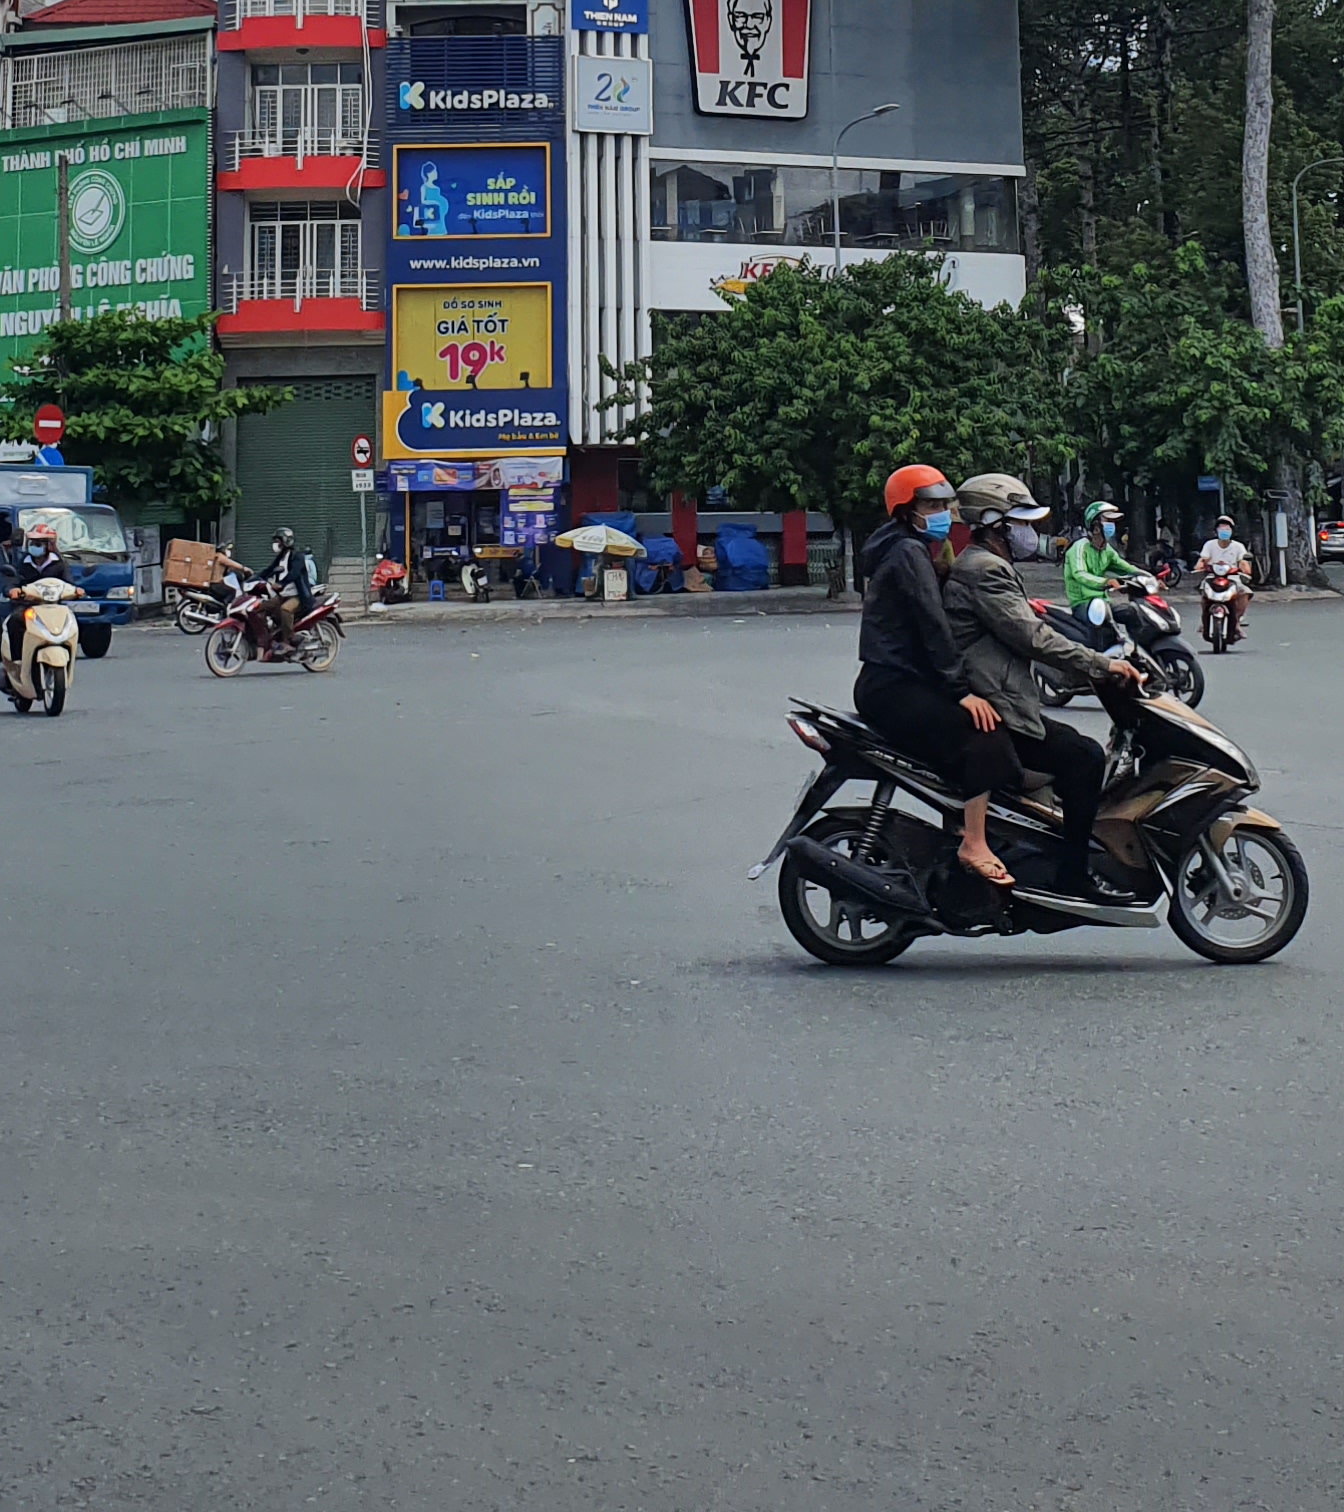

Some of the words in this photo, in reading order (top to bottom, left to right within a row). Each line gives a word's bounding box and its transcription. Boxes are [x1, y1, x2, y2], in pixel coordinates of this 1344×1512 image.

[614, 14, 637, 23] NAM
[716, 80, 790, 109] KFC
[1, 150, 51, 172] THÀNH
[55, 140, 85, 166] PHỐ
[89, 138, 111, 162] HỒ
[114, 137, 141, 159] CHÍ
[144, 136, 187, 156] MINH
[487, 172, 516, 189] SẮP
[467, 192, 505, 205] SINH
[507, 184, 536, 205] RỒI
[28, 261, 83, 291] PHÒG
[86, 256, 131, 287] CÔNG
[135, 250, 194, 283] CHỨNG
[409, 256, 540, 271] www.kidsplaza.vn
[443, 298, 458, 309] ĐỒ
[478, 300, 502, 308] SINH
[437, 315, 469, 335] GIÁ
[472, 312, 509, 333] TỐT
[439, 340, 506, 380] 19k
